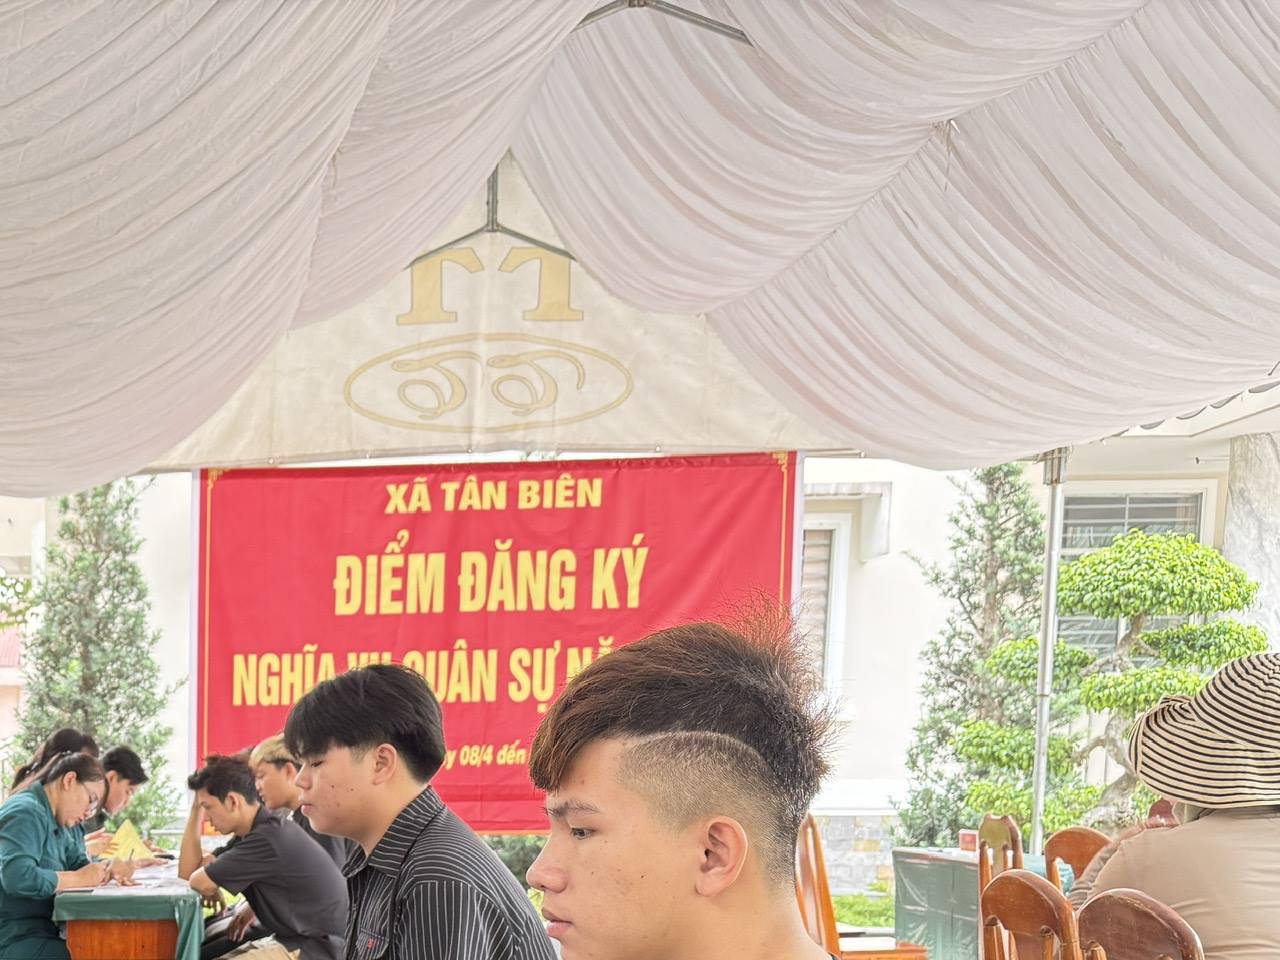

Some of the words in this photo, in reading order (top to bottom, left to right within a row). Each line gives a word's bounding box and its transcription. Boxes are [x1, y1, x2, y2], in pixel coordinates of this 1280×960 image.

[384, 477, 431, 514] XÃ
[440, 474, 507, 511] TÂN
[517, 472, 603, 509] BIÊN
[333, 529, 446, 615] ĐIỂM
[458, 538, 577, 612] ĐĂNG
[591, 533, 649, 610] KÝ
[508, 639, 561, 714] SỰ
[459, 743, 494, 768] 08/4
[496, 738, 527, 766] đến
